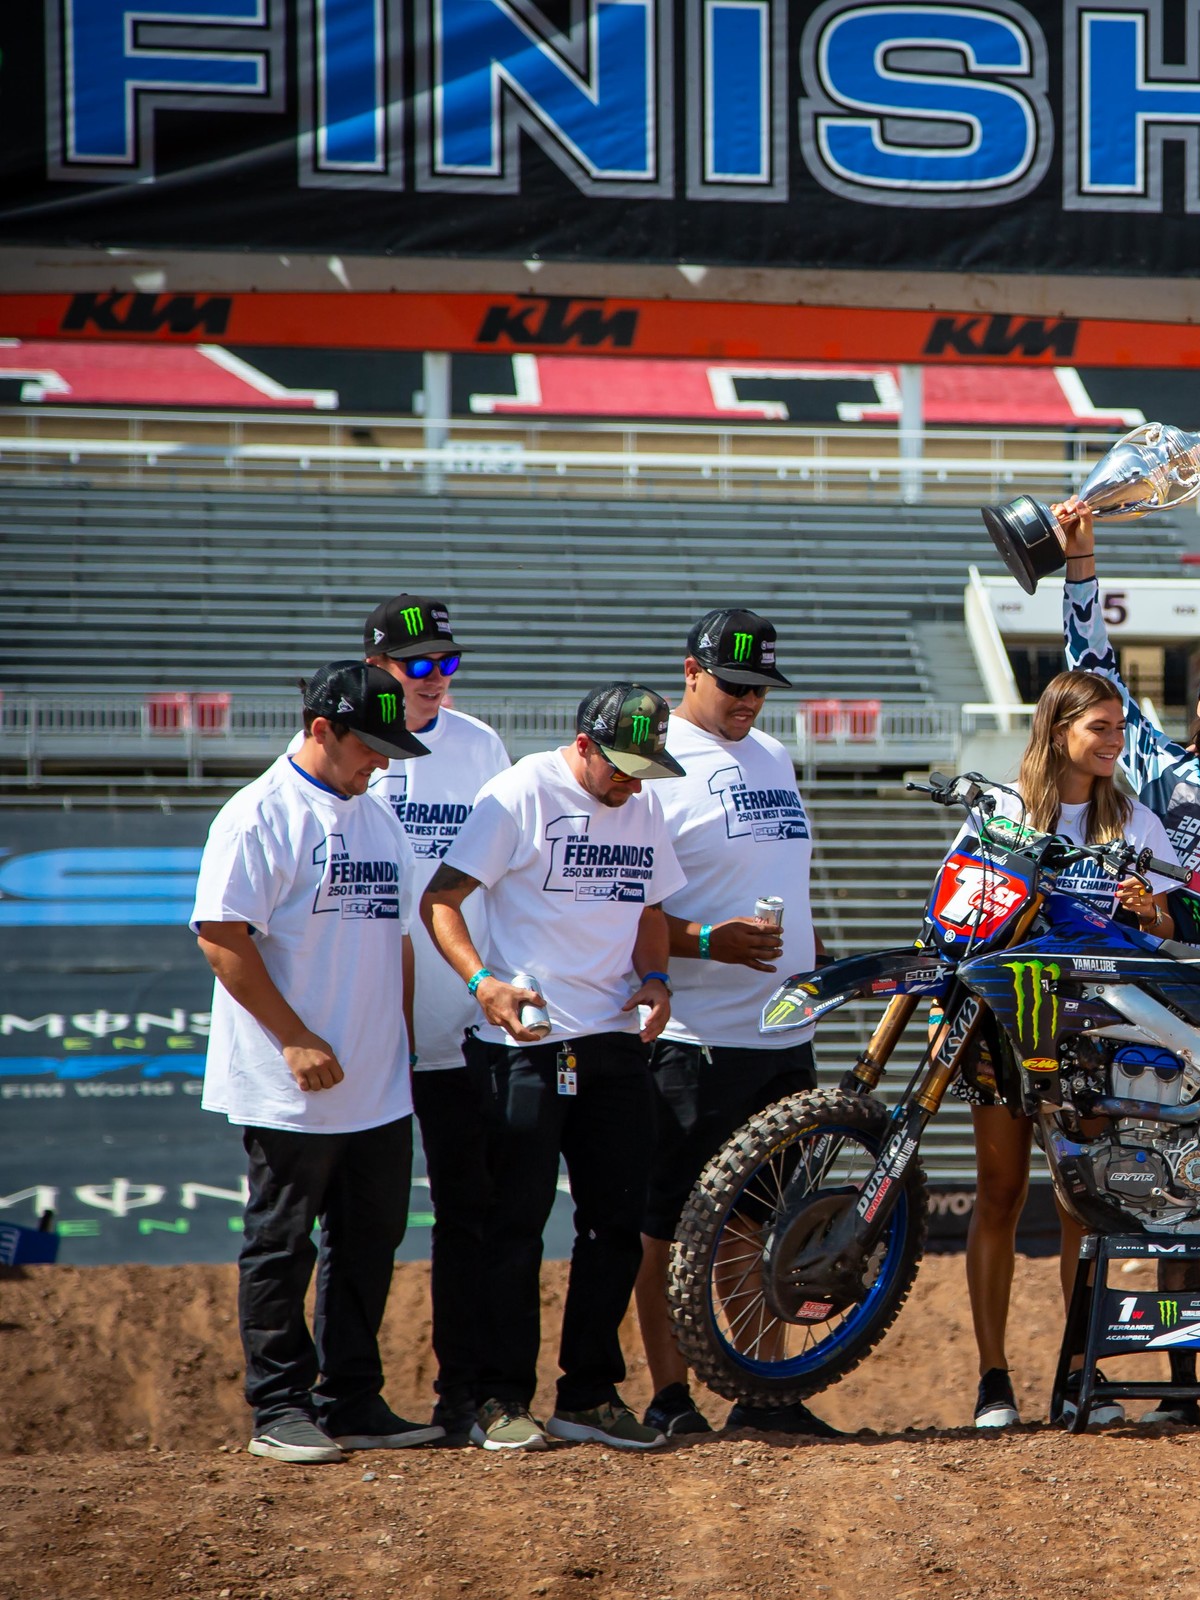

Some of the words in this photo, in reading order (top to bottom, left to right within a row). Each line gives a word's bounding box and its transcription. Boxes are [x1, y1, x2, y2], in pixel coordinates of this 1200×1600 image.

[61, 293, 233, 334] KTM
[476, 299, 641, 346] KTM
[923, 315, 1080, 357] KTM
[1103, 594, 1128, 625] 5
[729, 783, 747, 792] DYLAN
[731, 789, 802, 812] FERRANDIS
[391, 802, 473, 825] ERRAND
[737, 812, 753, 823] 250
[762, 809, 779, 819] WEST
[415, 825, 437, 836] WEST
[567, 835, 589, 843] DYLAN
[563, 844, 654, 869] FERRANDIS
[562, 867, 582, 878] 250
[582, 867, 594, 878] SX
[595, 867, 619, 878] WEST
[620, 868, 653, 880] CHAMPION
[327, 885, 347, 897] 250
[622, 888, 642, 897] THOR
[992, 886, 1022, 908] SX
[1080, 879, 1119, 893] CHAMPI
[1072, 958, 1118, 973] YAMALUBE
[938, 996, 980, 1068] KYB
[1, 1082, 65, 1099] FIM
[74, 1080, 175, 1099] World
[888, 1137, 919, 1179] YAMALUBE
[864, 1176, 893, 1223] BRAKING
[1117, 1296, 1138, 1323] 1
